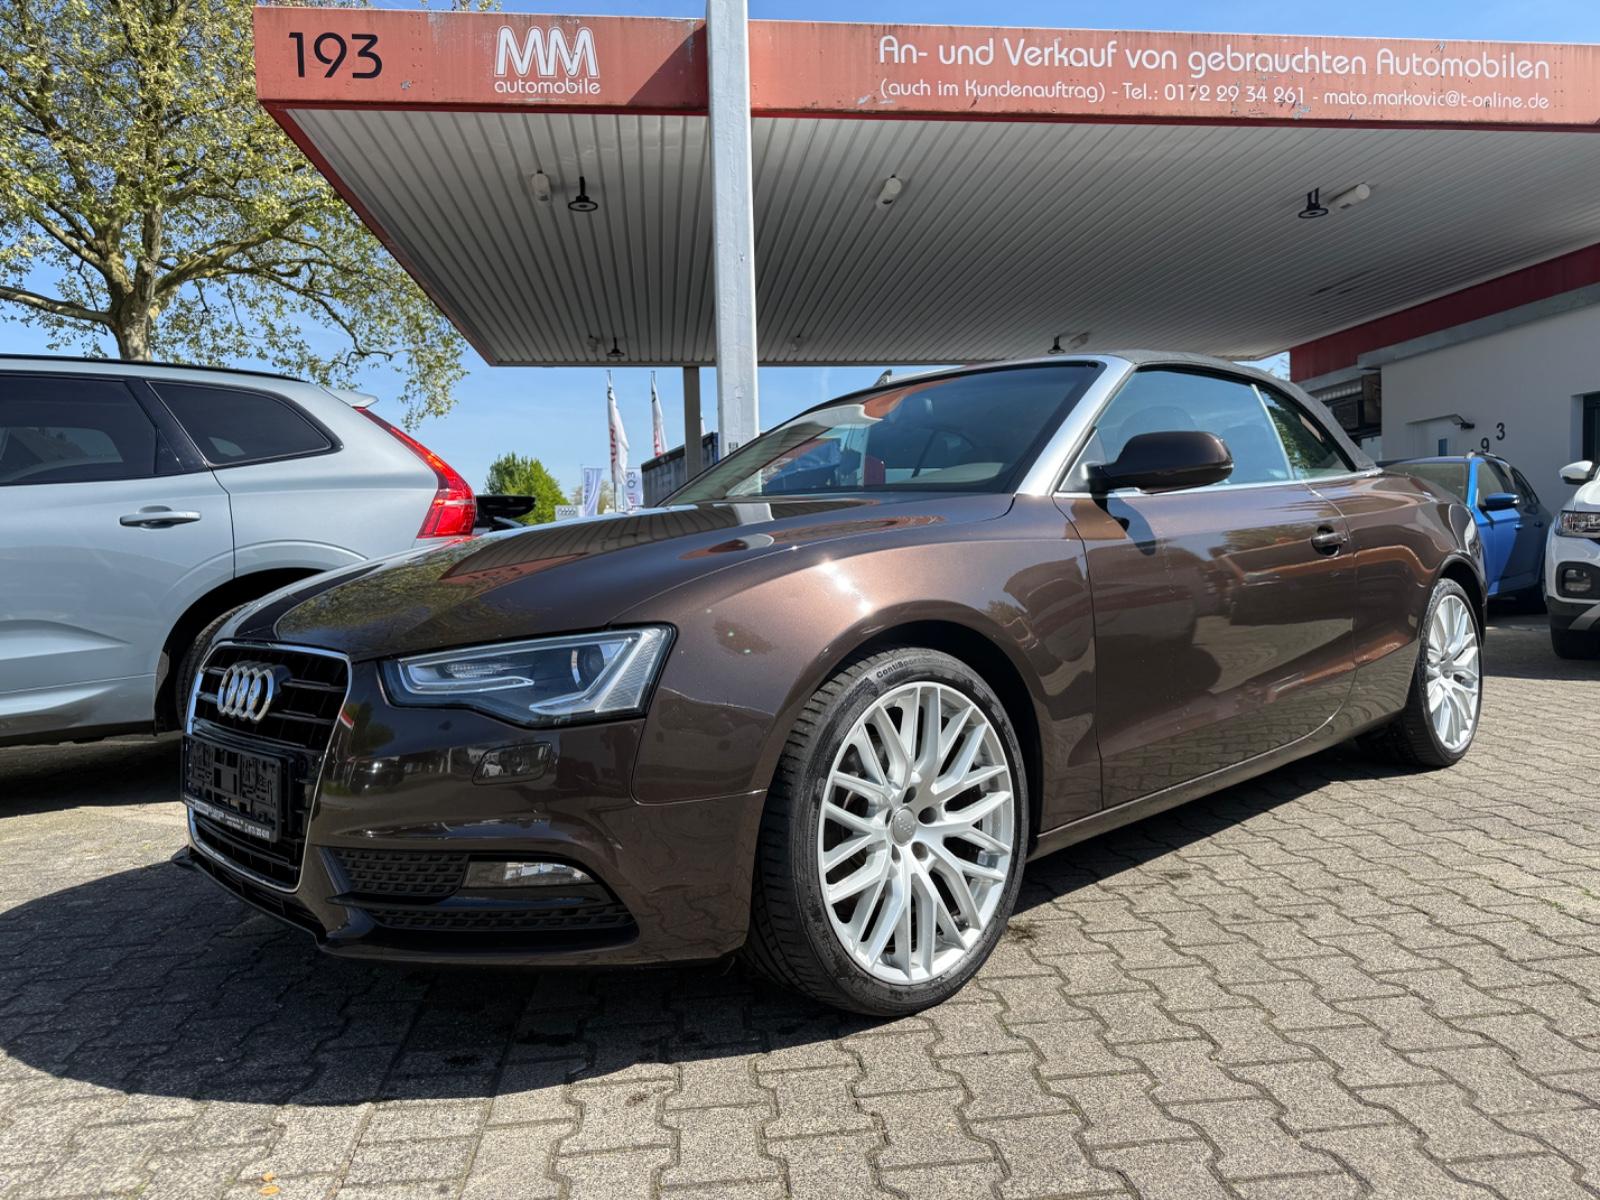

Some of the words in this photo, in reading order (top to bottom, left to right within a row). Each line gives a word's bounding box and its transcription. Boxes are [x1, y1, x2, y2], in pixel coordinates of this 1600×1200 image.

[288, 31, 383, 79] 193
[494, 25, 600, 78] MM
[879, 35, 928, 64] An-
[939, 38, 994, 66] und
[1003, 38, 1117, 67] Verkauf
[1125, 48, 1178, 70] von
[1188, 43, 1367, 78] gebrauchten
[1376, 47, 1550, 80] Automobilen
[494, 77, 600, 94] automobile
[880, 78, 931, 98] (auch
[938, 79, 959, 97] im
[966, 79, 1106, 103] Kundenauftrag)
[1122, 82, 1158, 101] Tel.:
[1164, 83, 1211, 102] 0172
[1216, 84, 1240, 102] 29
[1246, 86, 1268, 103] 34
[1273, 86, 1304, 104] 261
[1323, 90, 1550, 110] mato.markovic@t-online.de
[626, 471, 637, 490] Q3
